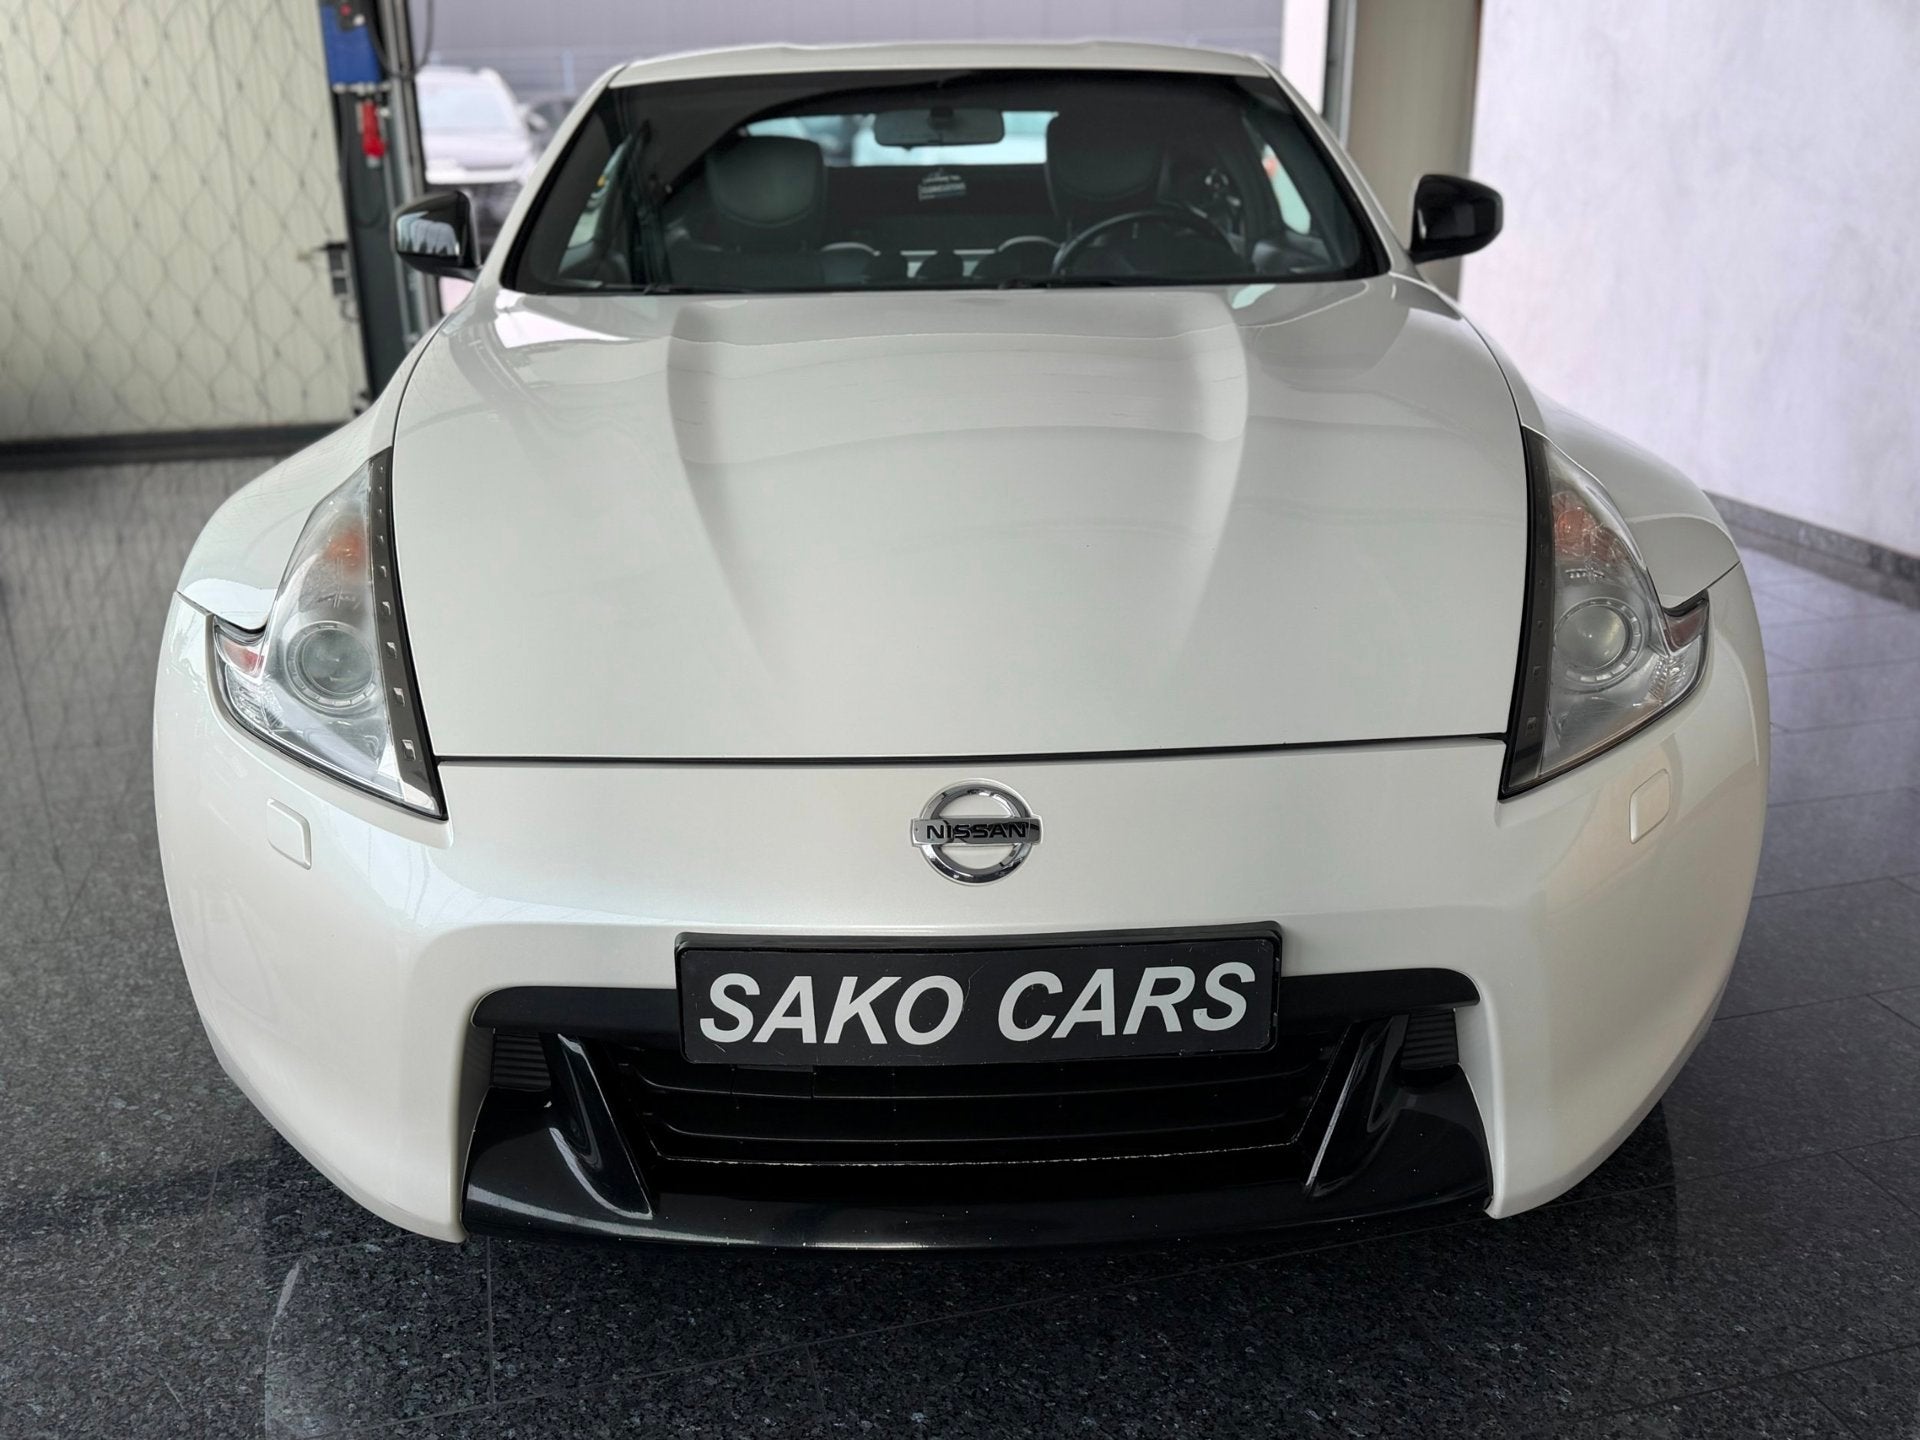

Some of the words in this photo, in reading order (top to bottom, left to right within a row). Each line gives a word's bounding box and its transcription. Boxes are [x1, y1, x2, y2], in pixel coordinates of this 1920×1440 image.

[926, 822, 1027, 839] NISSAN
[700, 973, 963, 1045] SAKO
[998, 962, 1255, 1042] CARS
